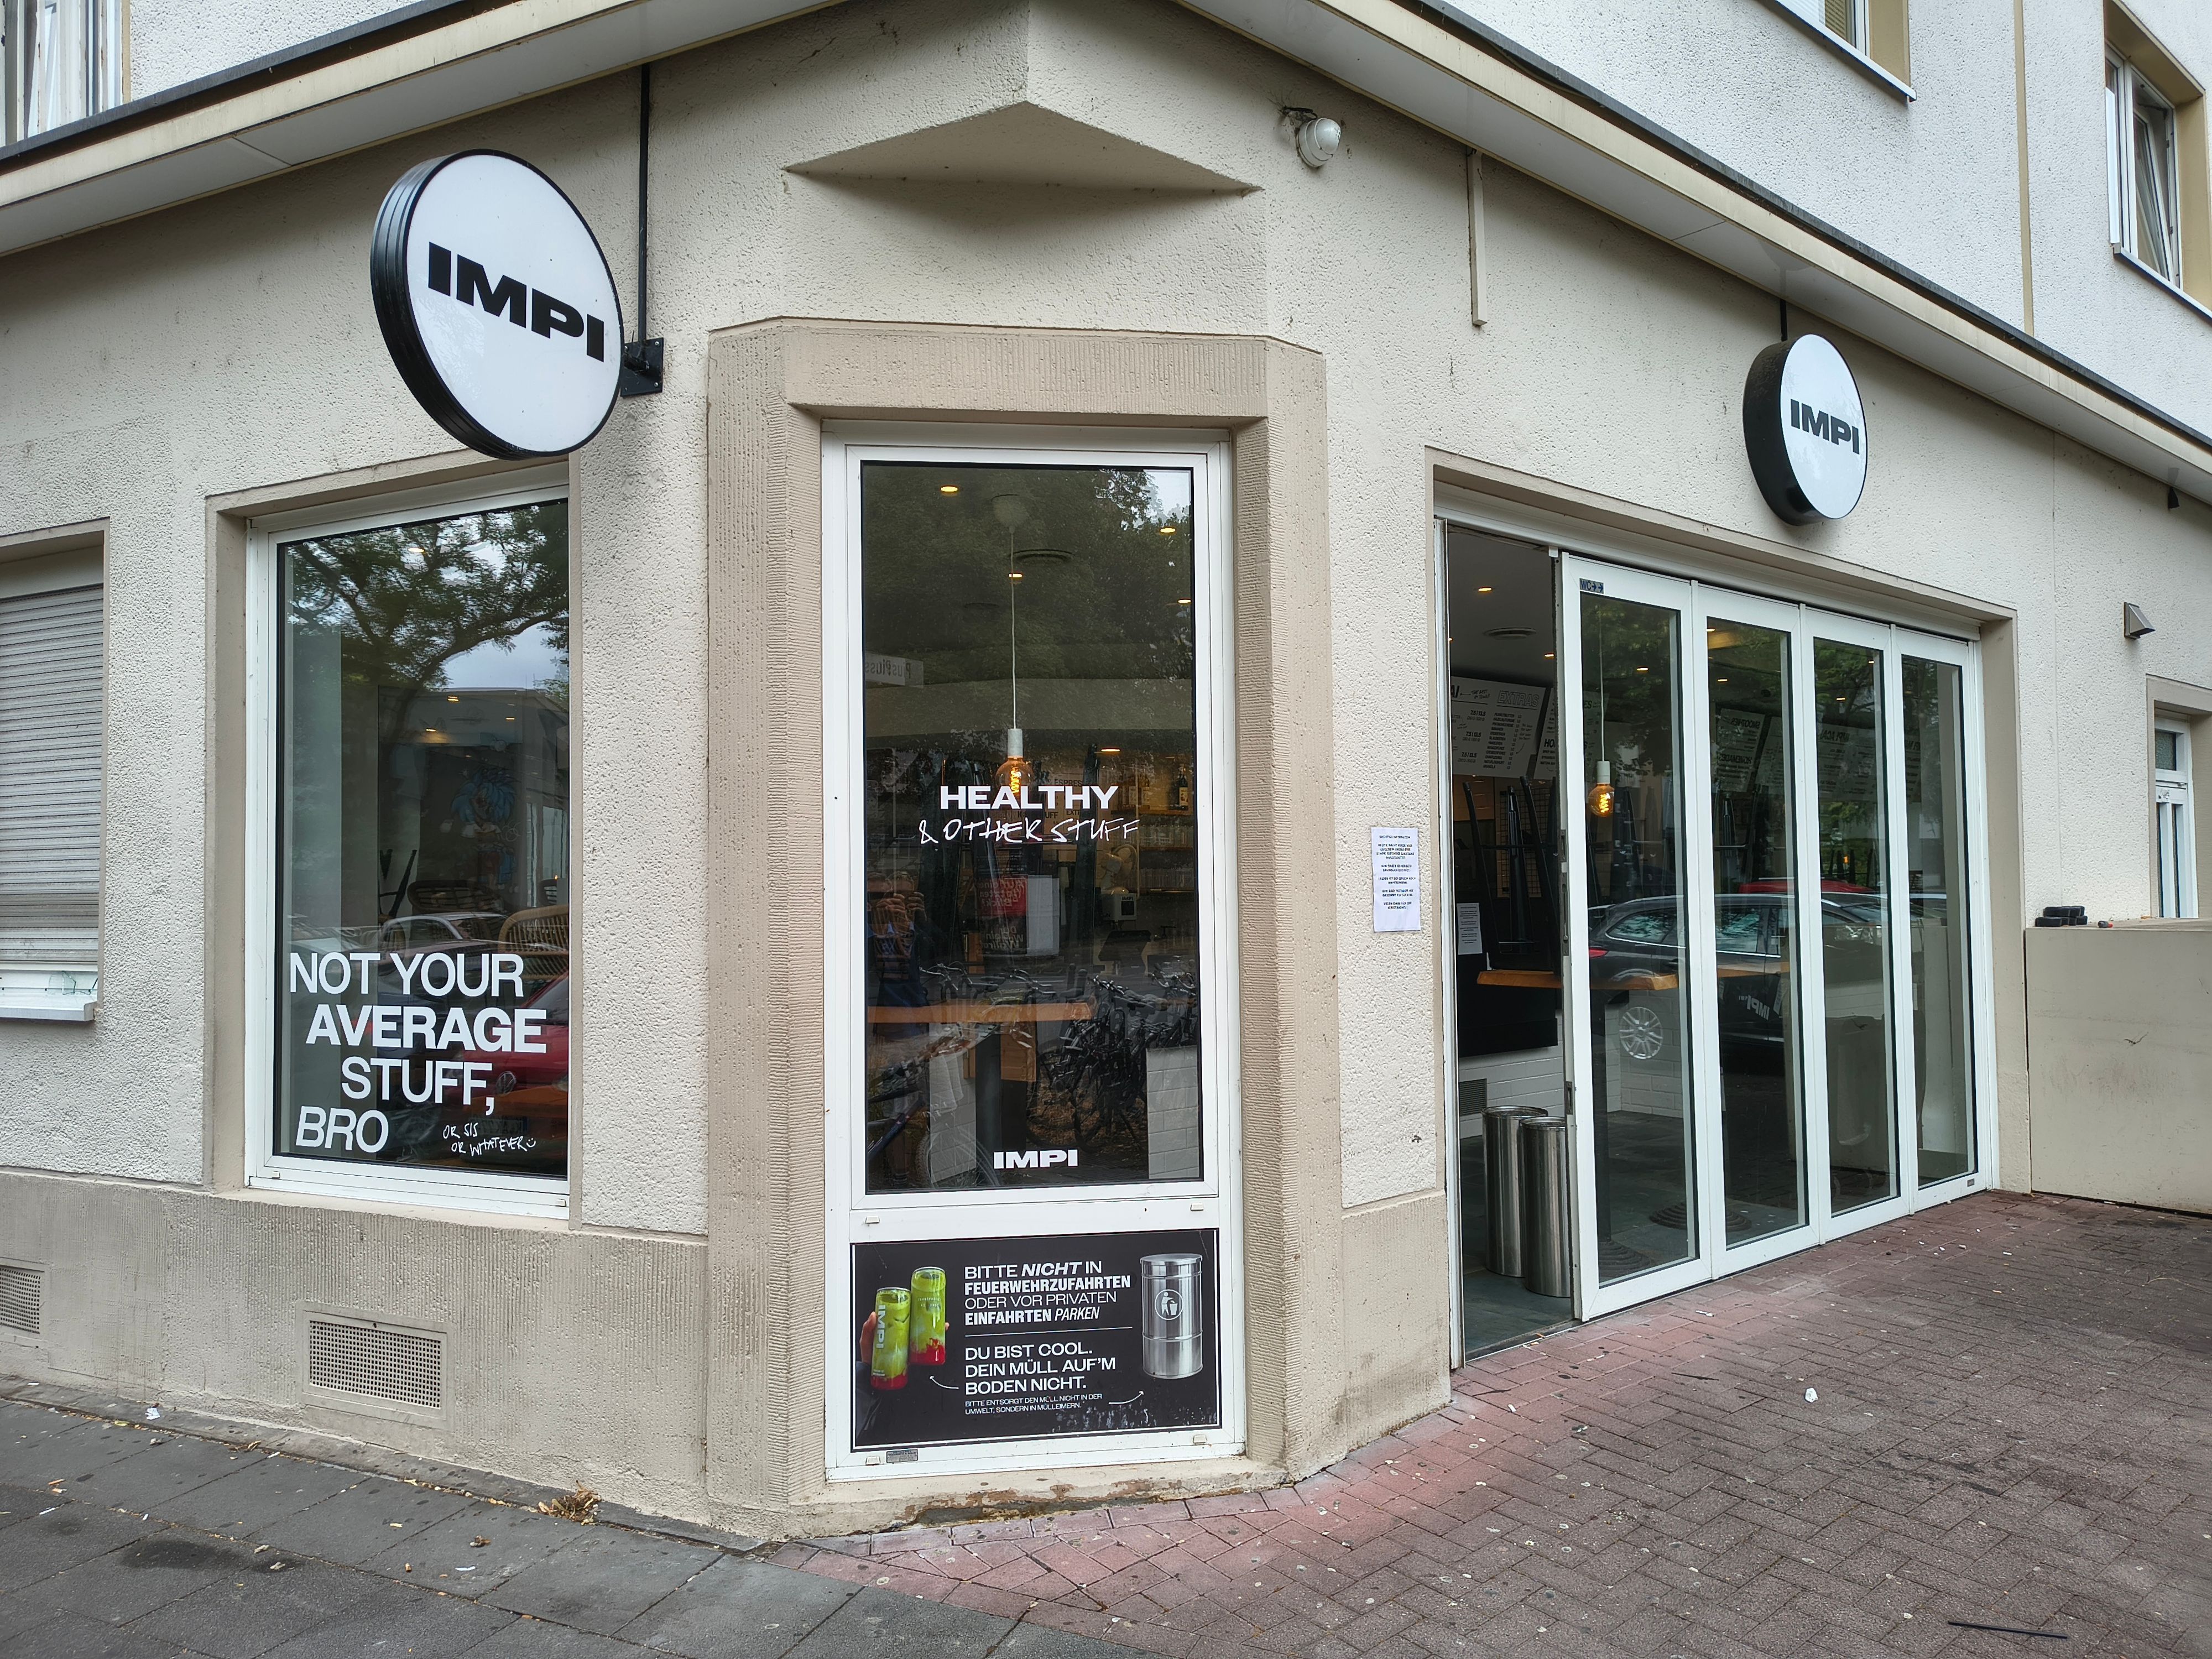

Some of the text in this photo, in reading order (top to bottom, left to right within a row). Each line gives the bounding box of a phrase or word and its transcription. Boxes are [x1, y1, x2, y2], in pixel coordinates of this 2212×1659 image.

[429, 242, 604, 363] IMPI
[1790, 399, 1860, 455] IMPI
[1580, 580, 1592, 591] WC
[1497, 690, 1540, 707] EXTRAS
[940, 786, 1118, 809] HEALTHY
[919, 818, 1140, 844] & OTHER STUFF
[290, 952, 524, 997] NOT YOUR
[306, 1004, 546, 1053] AVERAGE
[342, 1056, 494, 1115] STUFF,
[296, 1106, 389, 1153] BRO
[443, 1125, 460, 1139] OR
[463, 1123, 478, 1137] SIS
[451, 1136, 527, 1156] OR WHATEVER
[994, 1149, 1078, 1168] IMPI
[964, 1261, 1102, 1279] BITTE NICHT IN
[964, 1275, 1130, 1295] FEUERWEHRZUFAHRTEN
[964, 1291, 1117, 1310] ODER VOR PRIVATEN
[965, 1306, 1100, 1326] EINFAHRTEN PARKEN
[876, 1305, 886, 1348] IMPI
[965, 1342, 1093, 1360] DU BIST COOL.
[966, 1357, 1116, 1378] DEIN MÜLL AUF'M
[966, 1376, 1087, 1395] BODEN NICHT.
[1037, 1402, 1082, 1411] MÜLLEIMERN.
[1039, 1395, 1058, 1403] MÜLL
